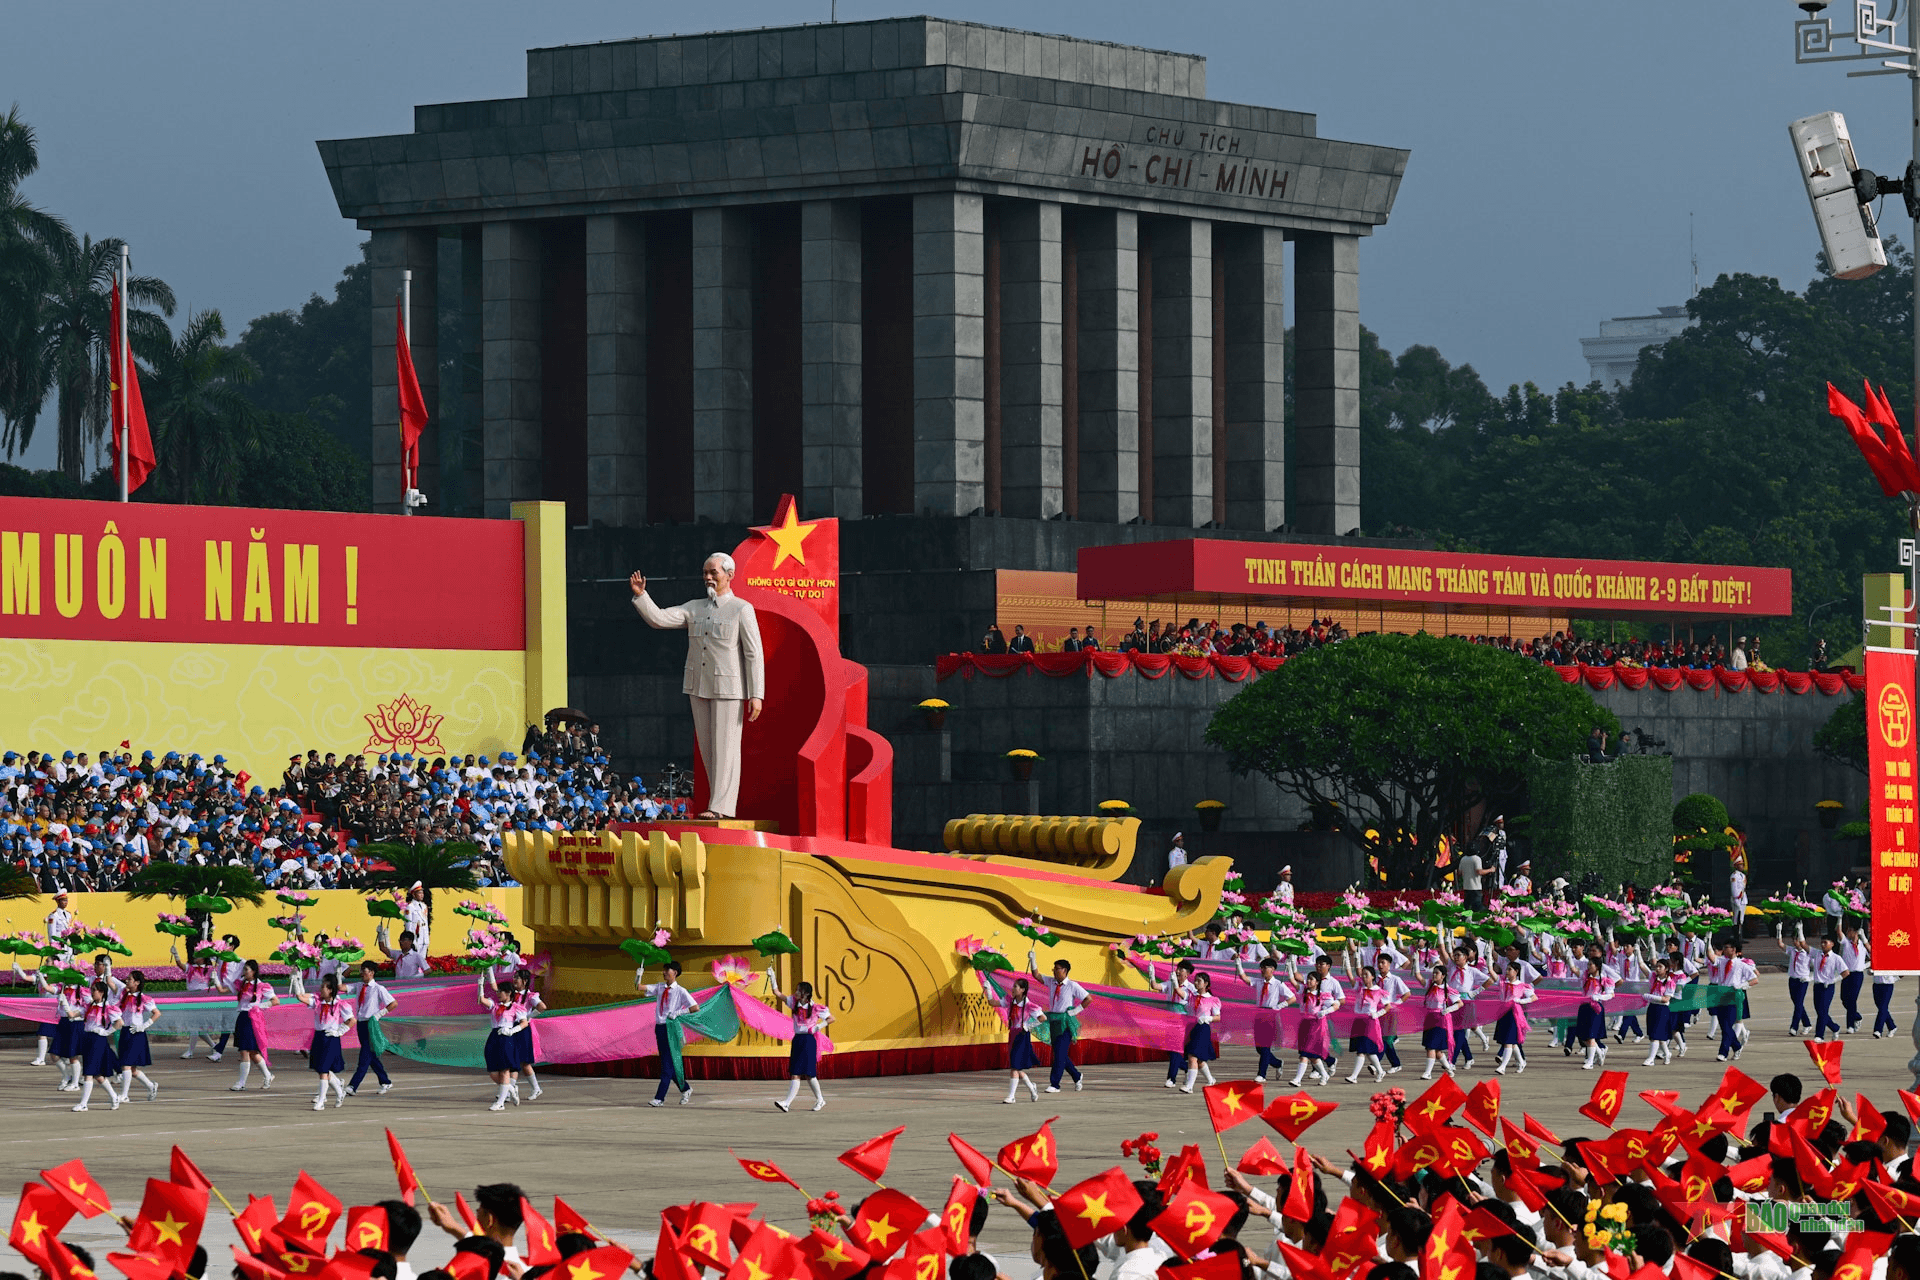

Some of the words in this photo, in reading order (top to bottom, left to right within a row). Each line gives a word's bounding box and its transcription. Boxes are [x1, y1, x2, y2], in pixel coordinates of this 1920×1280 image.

[1081, 143, 1126, 179] HỒ
[1216, 157, 1289, 198] MINH
[1, 520, 167, 620] MUÔN
[205, 527, 320, 625] NĂM
[747, 576, 772, 587] KHÔNG
[1245, 557, 1287, 585] TINH
[1290, 553, 1336, 588] THẦN
[1340, 558, 1383, 590] CÁCH
[1387, 565, 1433, 596] MẠNG
[1436, 564, 1489, 595] THÁNG
[1492, 566, 1526, 596] TÁM
[1529, 568, 1550, 597] VÀ
[1553, 567, 1592, 599] QUỐC
[1596, 571, 1646, 600] KHÁNH
[1649, 577, 1677, 602] 2-9
[1680, 573, 1709, 603] BẤT
